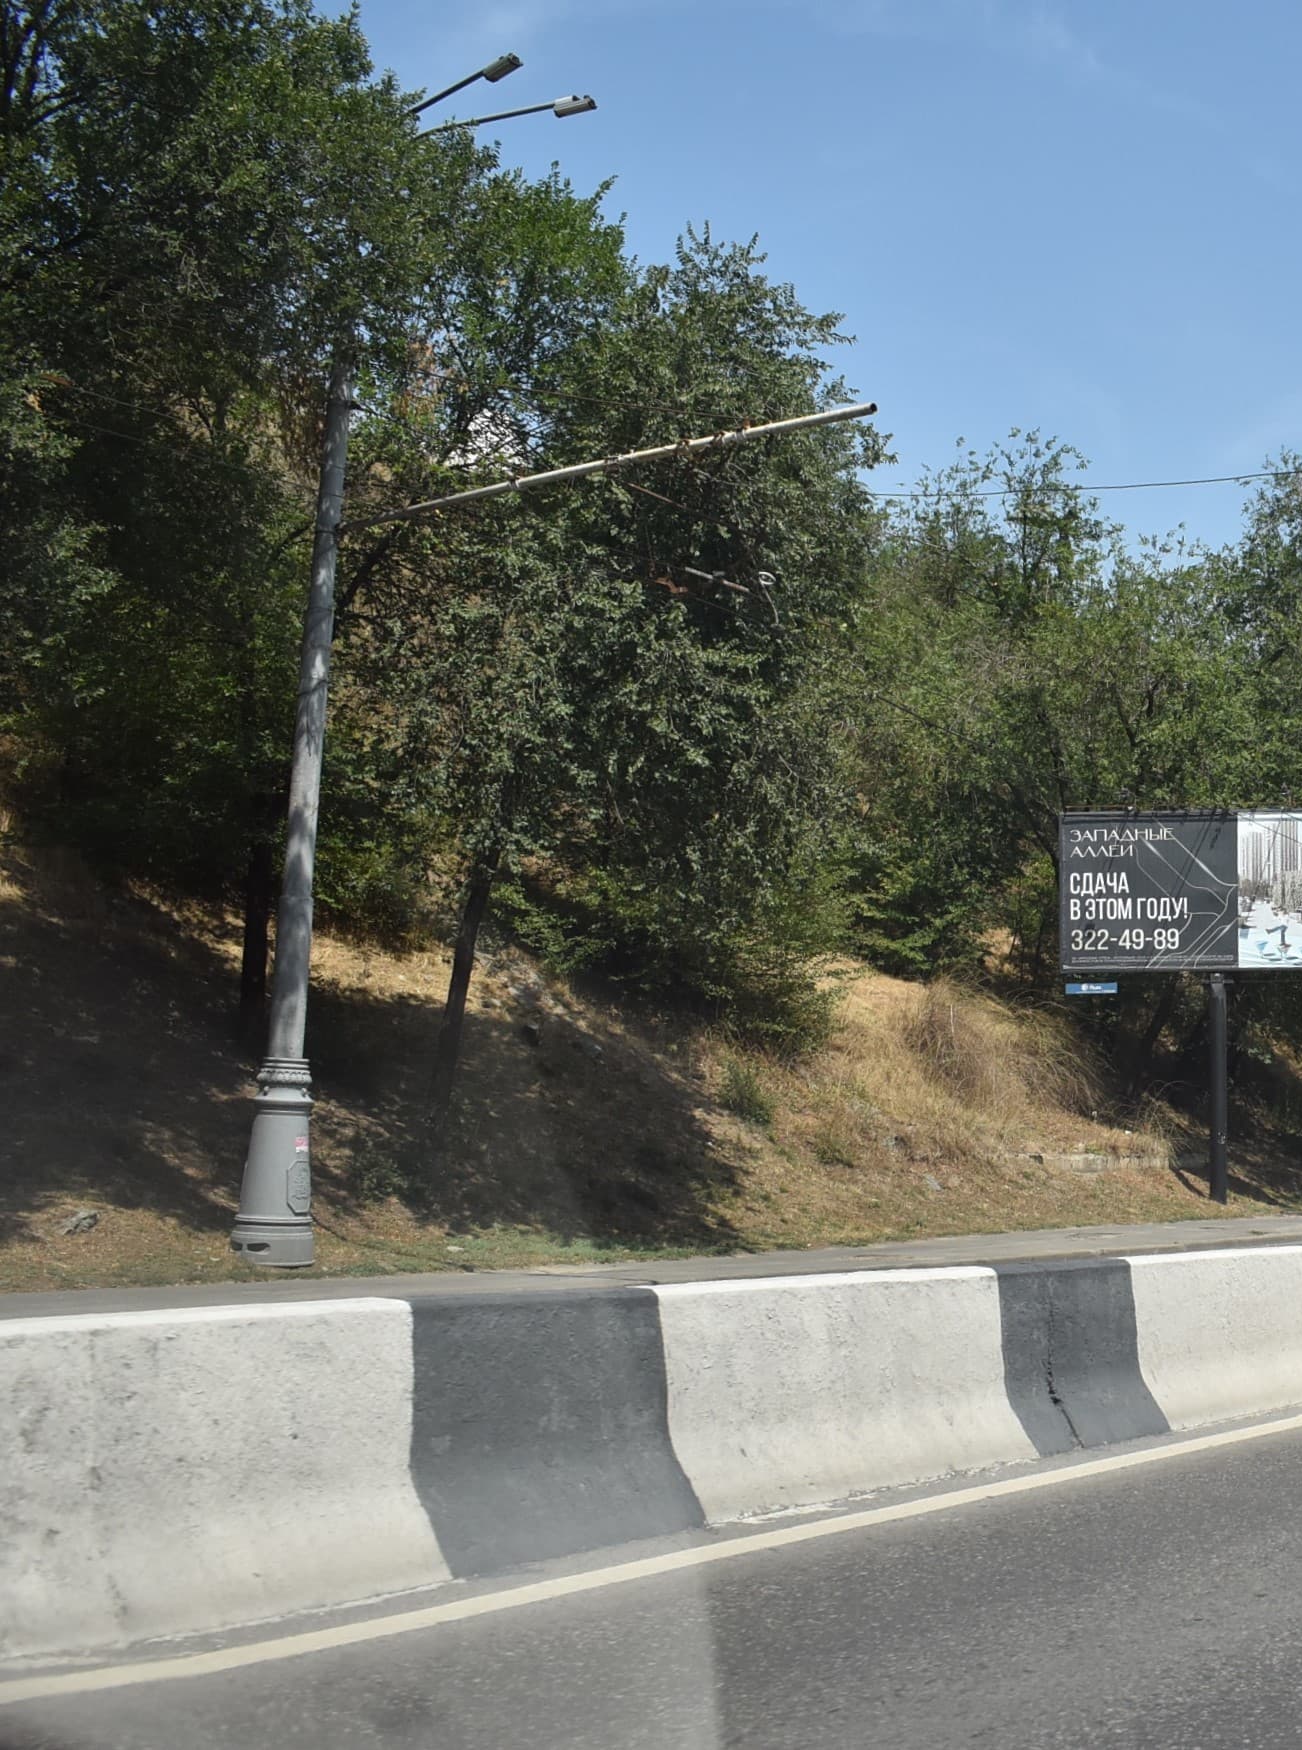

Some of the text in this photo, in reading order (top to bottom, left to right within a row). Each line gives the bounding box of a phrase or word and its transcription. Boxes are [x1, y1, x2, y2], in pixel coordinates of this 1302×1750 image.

[1070, 828, 1176, 841] ЗАПАДНЫЕ
[1070, 872, 1129, 896] СДАЧА
[1070, 897, 1188, 921] В ЭТОМ ГОДУ!
[1071, 928, 1180, 950] 322-49-89
